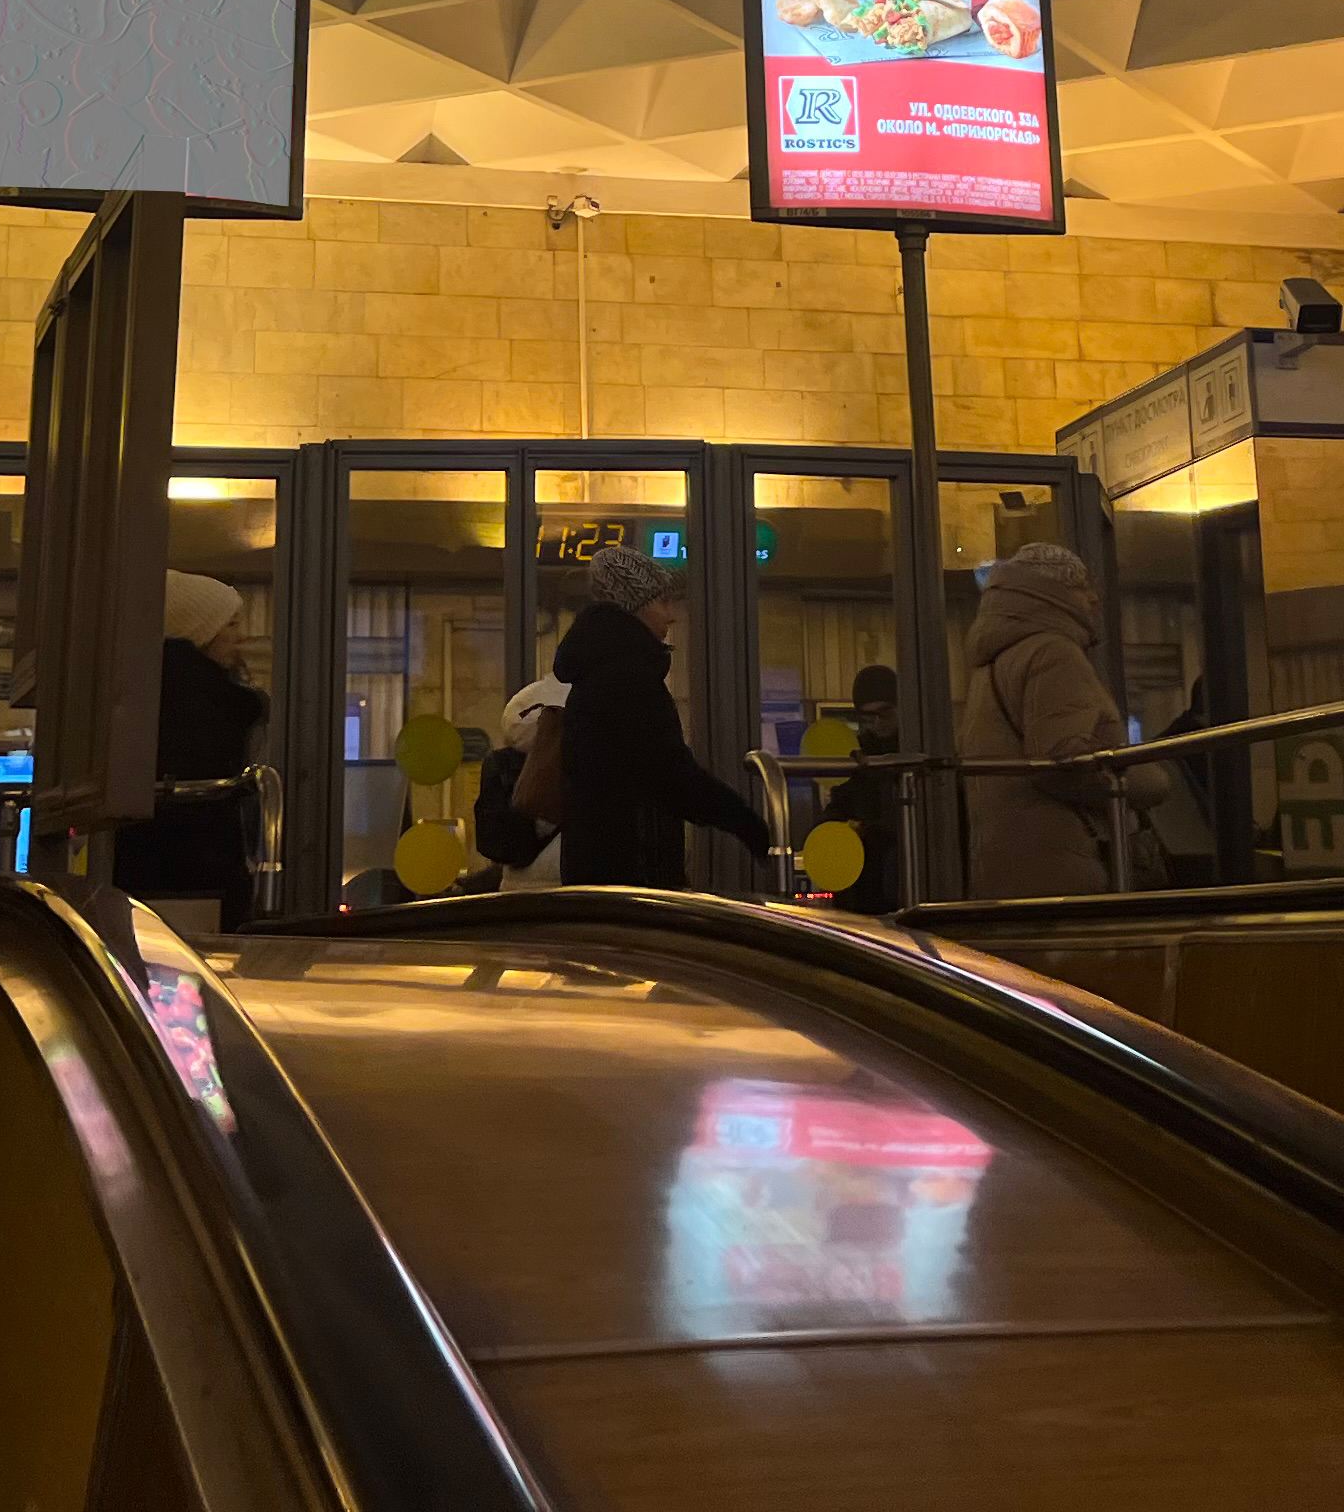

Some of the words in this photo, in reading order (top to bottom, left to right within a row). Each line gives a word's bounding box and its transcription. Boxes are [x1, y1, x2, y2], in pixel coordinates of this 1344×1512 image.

[909, 102, 931, 117] УЛ.
[934, 103, 1017, 127] ОДОЕВСКОГО,
[784, 138, 856, 149] ROSTIC'S
[877, 119, 922, 134] ОКОЛО
[926, 121, 940, 136] М.
[943, 123, 1040, 144] «ПРИМОРСКАЯ»
